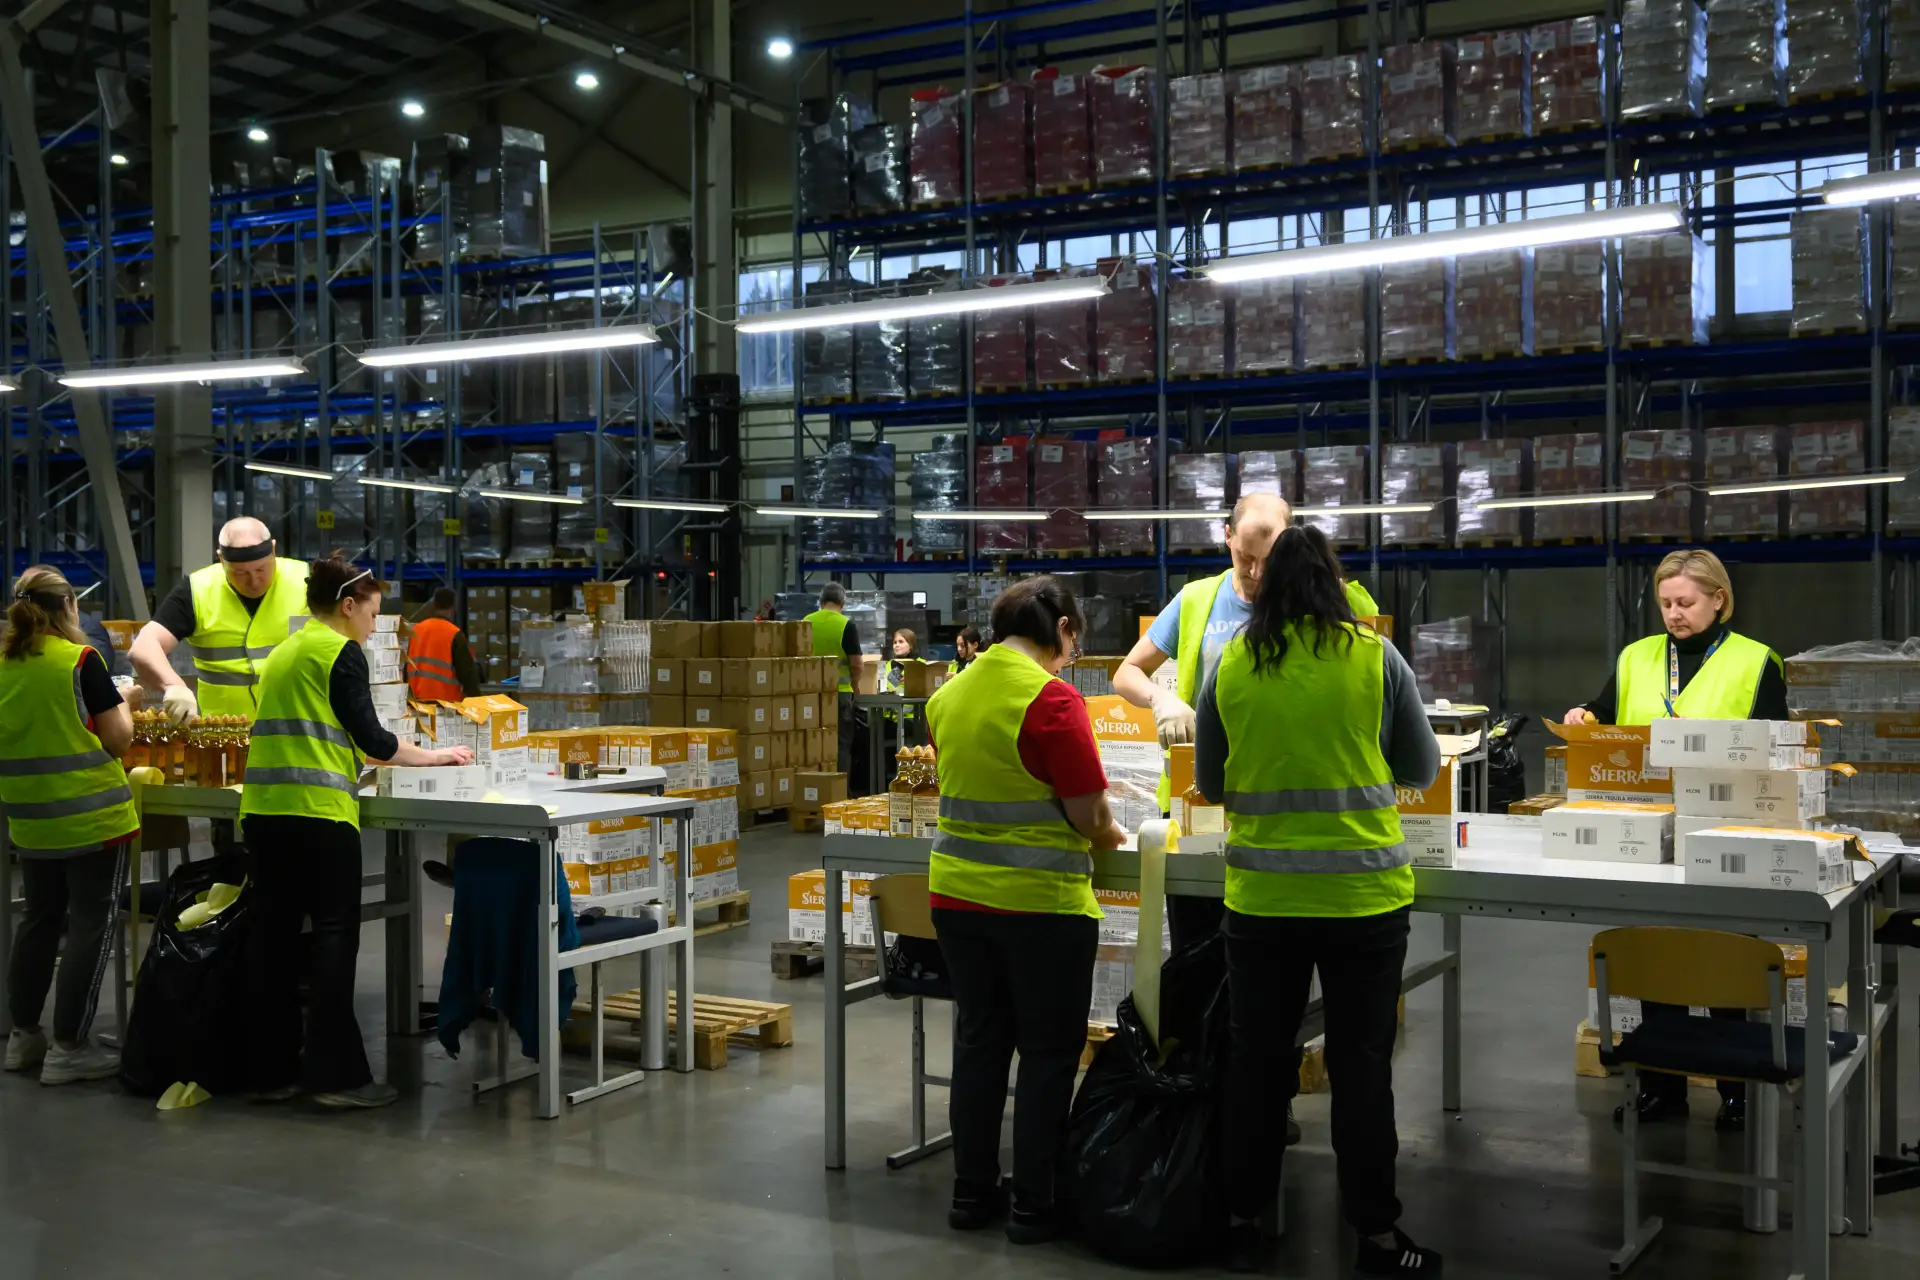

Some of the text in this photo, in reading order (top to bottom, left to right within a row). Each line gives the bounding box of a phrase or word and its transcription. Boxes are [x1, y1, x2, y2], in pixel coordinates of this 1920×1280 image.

[1094, 717, 1141, 735] SIERRA
[1590, 732, 1643, 740] SIERRA
[567, 750, 590, 761] SIERRA
[658, 748, 680, 760] SIERRA
[600, 816, 625, 829] SIERRA
[1426, 847, 1436, 855] 5,8
[802, 891, 826, 905] SIER
